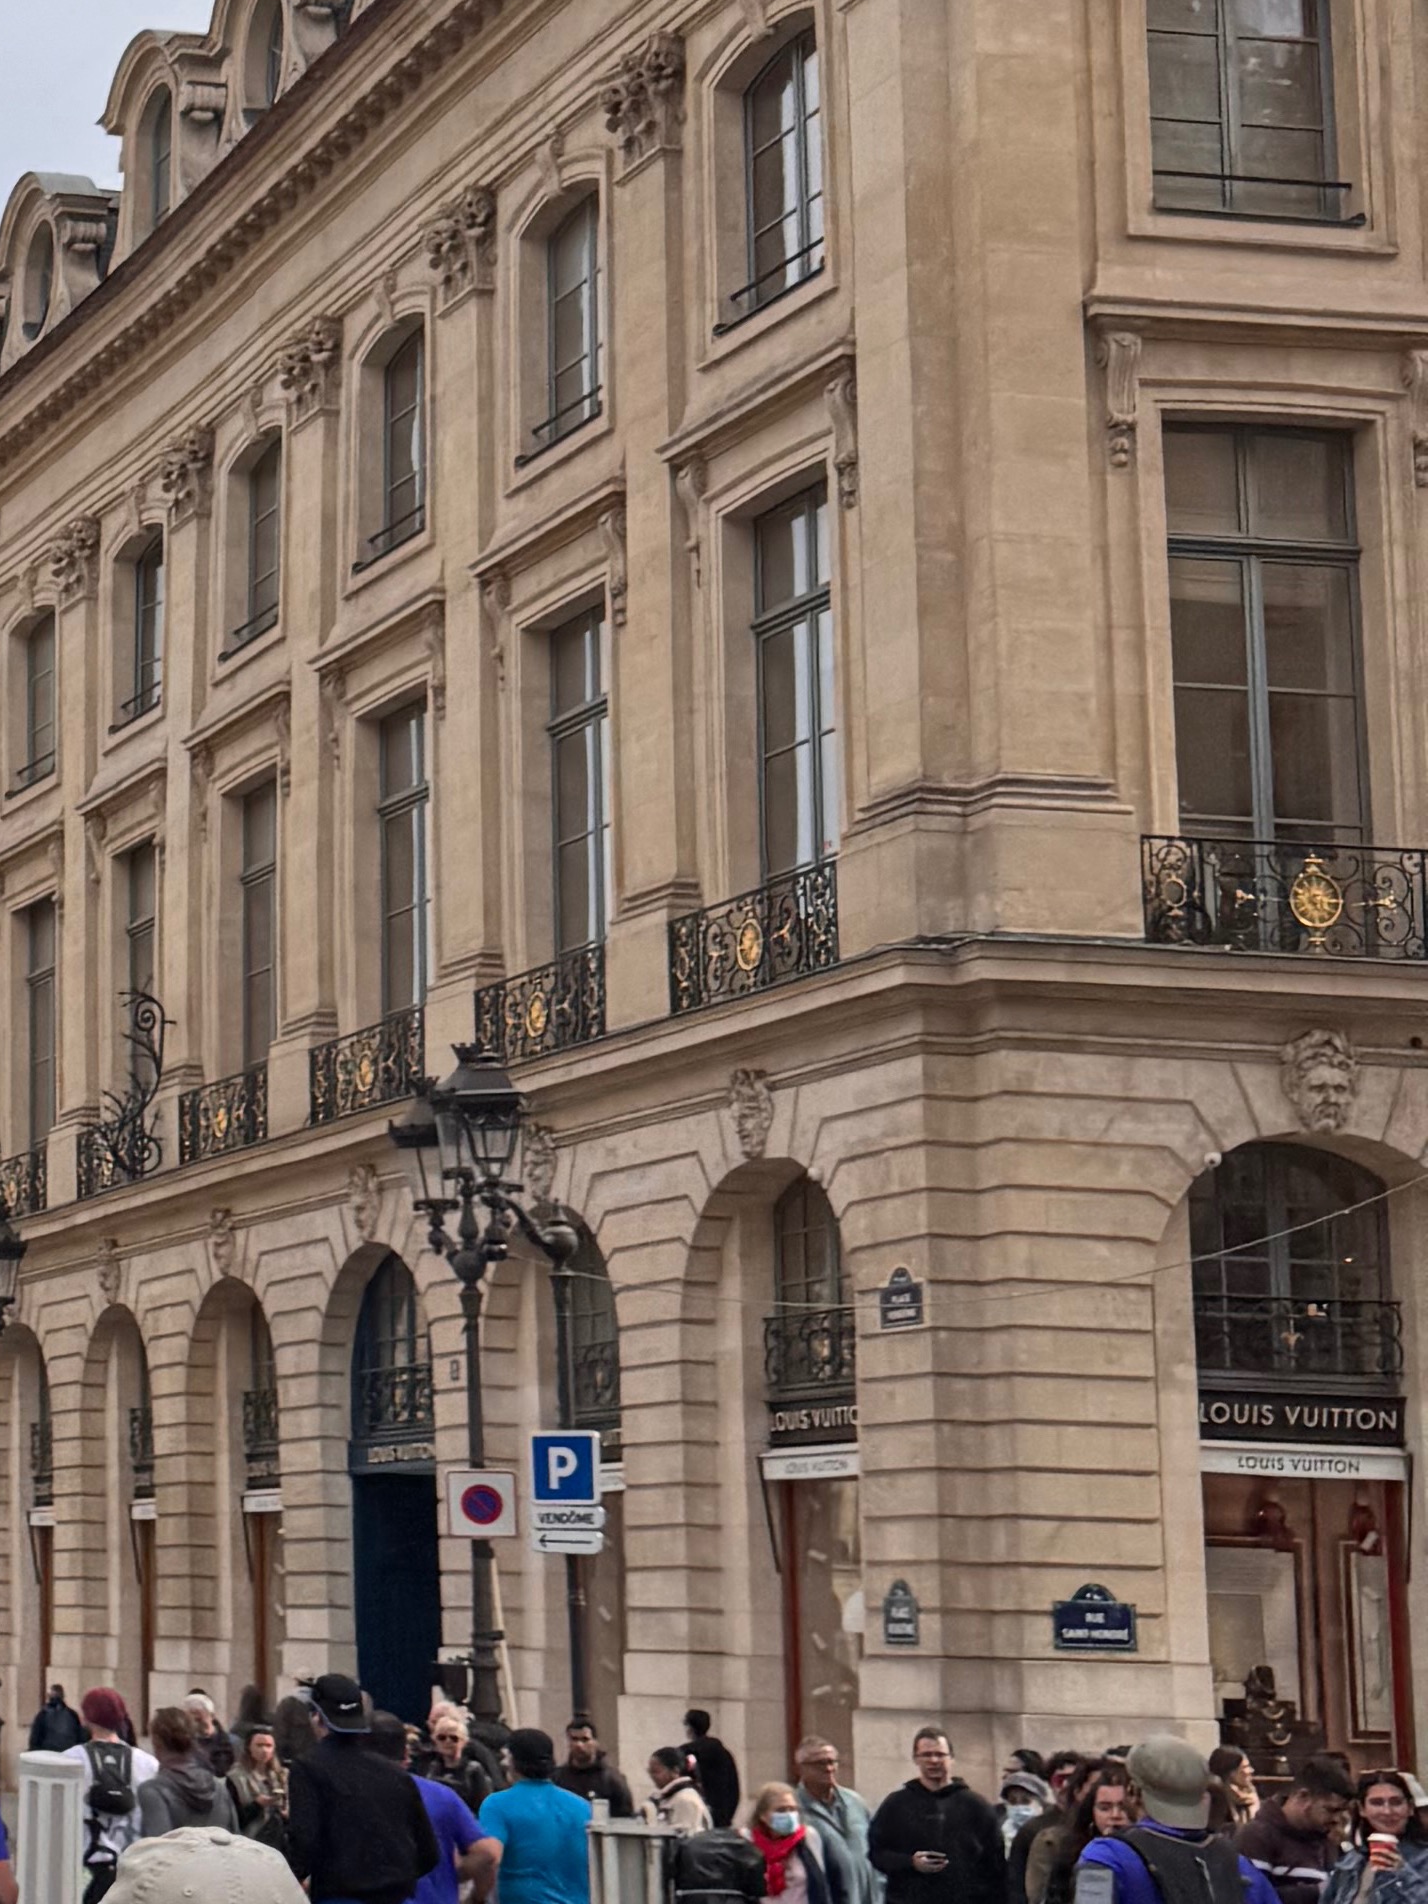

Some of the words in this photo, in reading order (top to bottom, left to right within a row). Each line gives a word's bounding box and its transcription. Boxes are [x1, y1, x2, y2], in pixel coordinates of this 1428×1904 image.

[1199, 1402, 1274, 1426] LOUIS
[1284, 1404, 1398, 1430] VUITTON
[548, 1446, 578, 1490] P
[1238, 1456, 1285, 1472] LOUIS
[1291, 1458, 1361, 1474] VUITTON
[538, 1509, 595, 1524] VENDÔME
